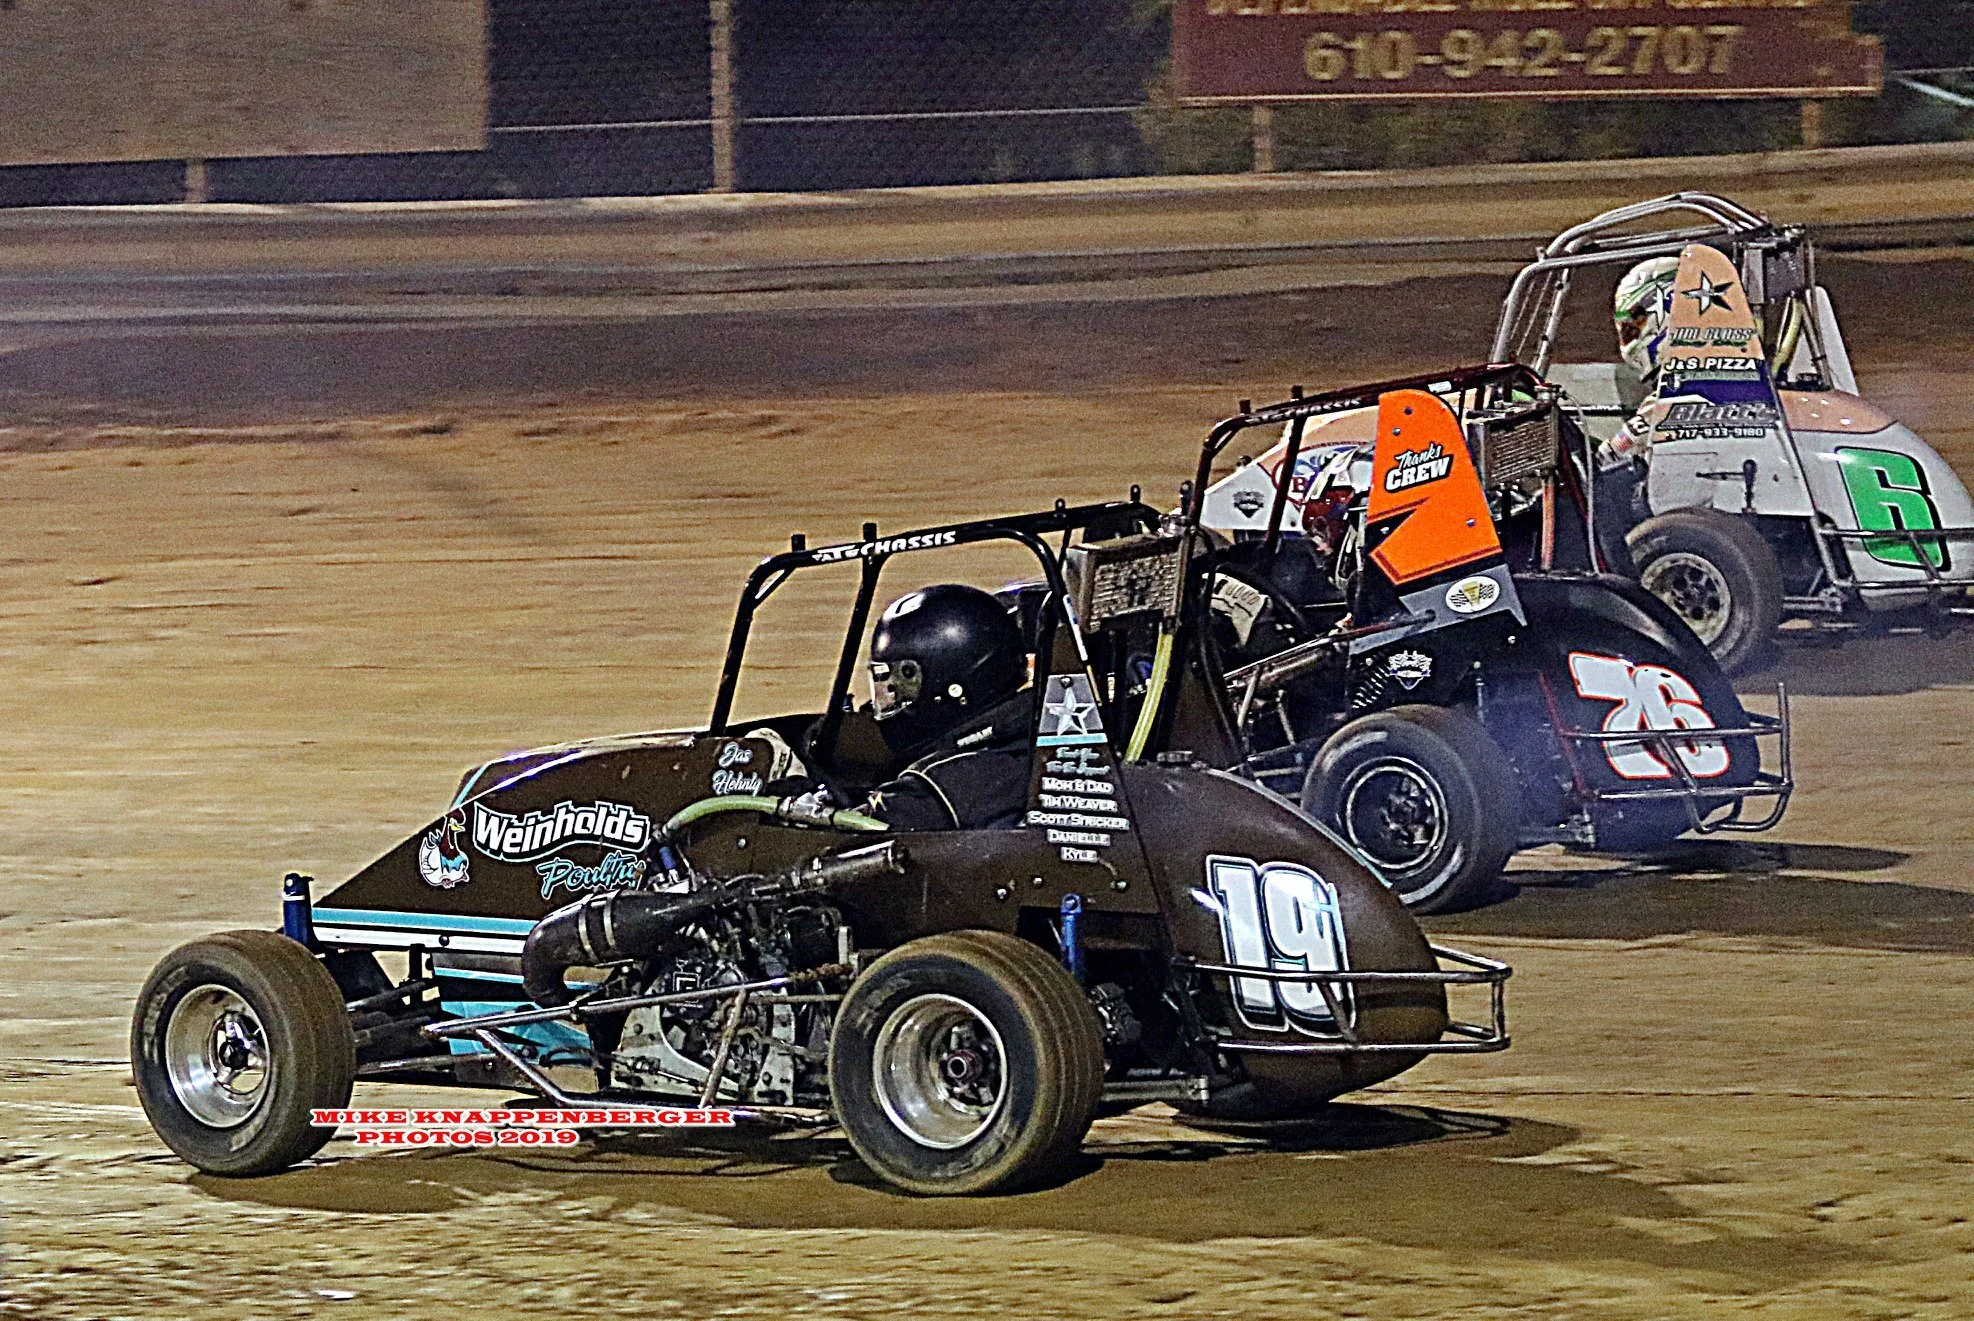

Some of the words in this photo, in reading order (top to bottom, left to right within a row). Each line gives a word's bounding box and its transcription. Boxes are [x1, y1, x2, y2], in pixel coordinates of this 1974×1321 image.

[1304, 25, 1743, 81] 610-942-2707
[1665, 358, 1699, 370] J&S
[1705, 358, 1757, 370] PIZZA
[1385, 456, 1451, 491] CREW
[1394, 442, 1442, 471] Thanks
[1835, 446, 1949, 570] 6
[1568, 652, 1731, 780] 76
[719, 742, 753, 768] Jas
[474, 803, 648, 858] Weinholds
[1208, 858, 1351, 1034] 19
